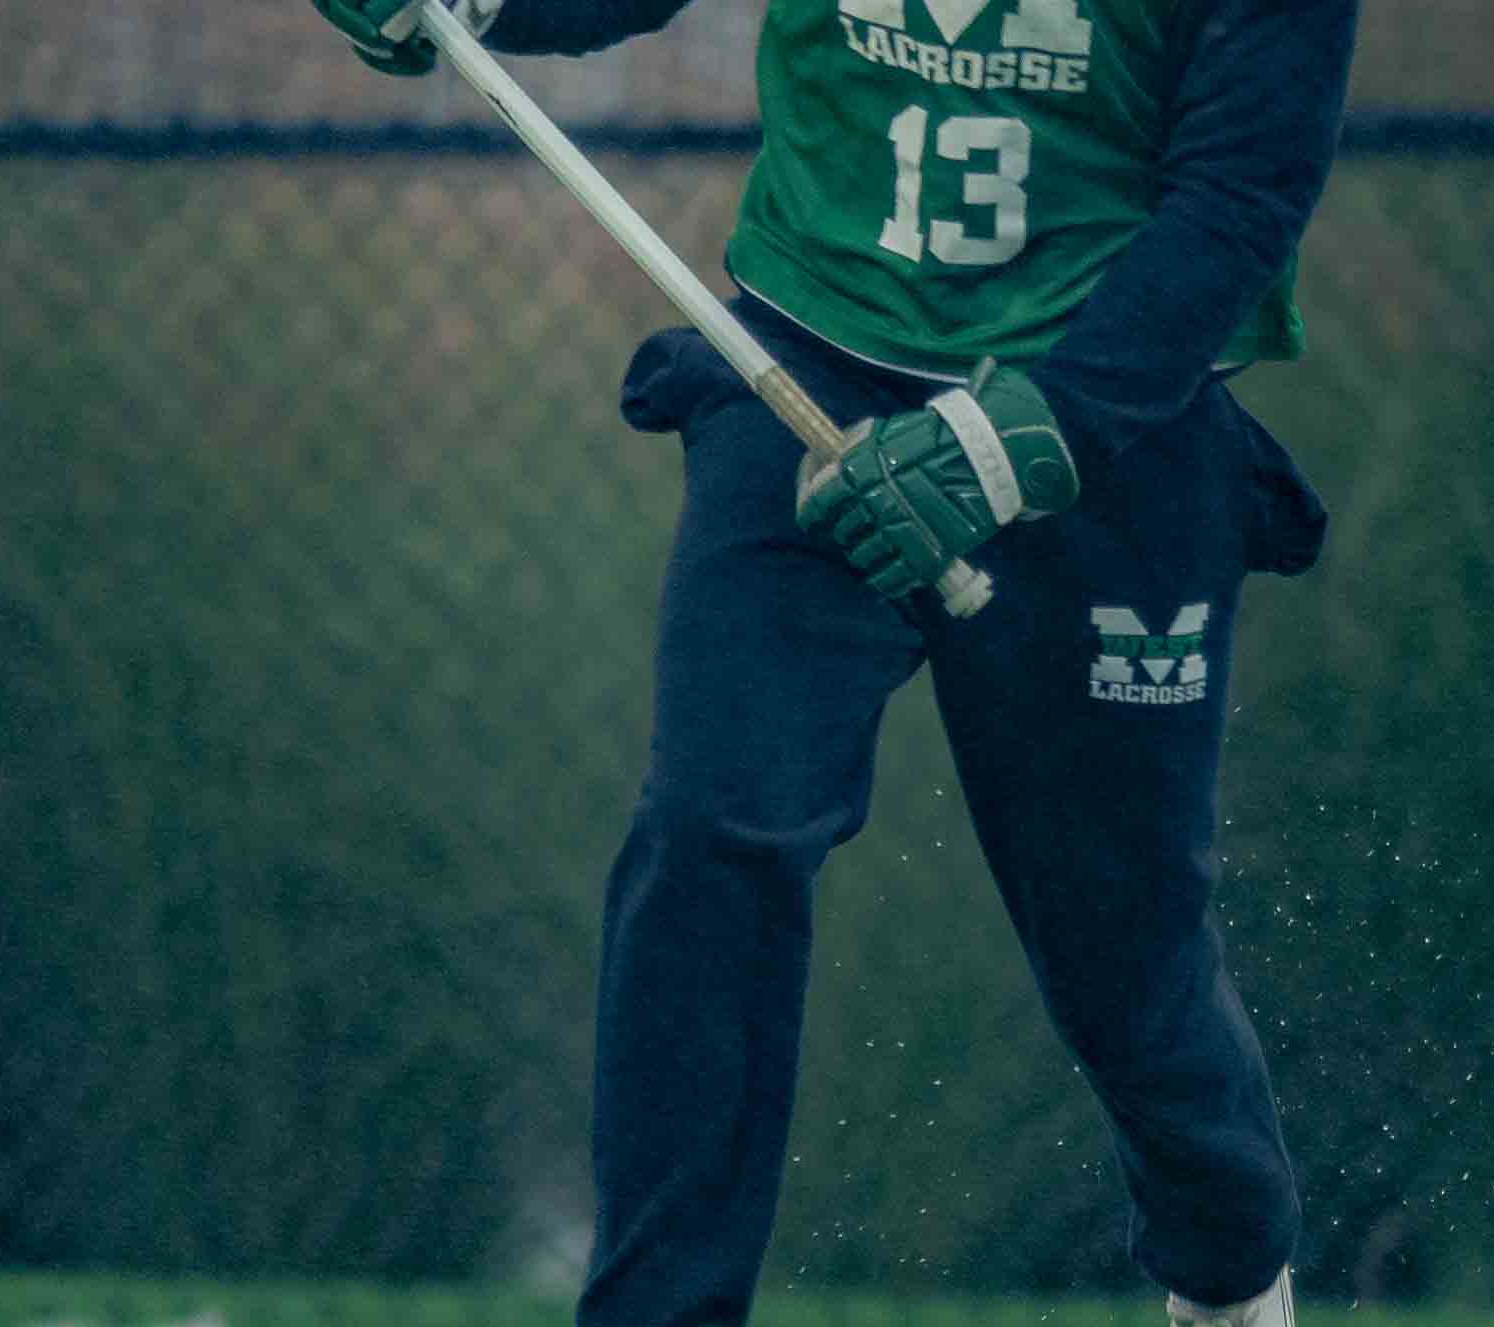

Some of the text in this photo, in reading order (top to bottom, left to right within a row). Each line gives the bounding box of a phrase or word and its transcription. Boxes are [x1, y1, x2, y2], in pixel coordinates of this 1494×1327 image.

[838, 15, 1090, 93] LACROSSE
[877, 103, 1032, 266] 13
[1089, 679, 1207, 705] LACROSSE
